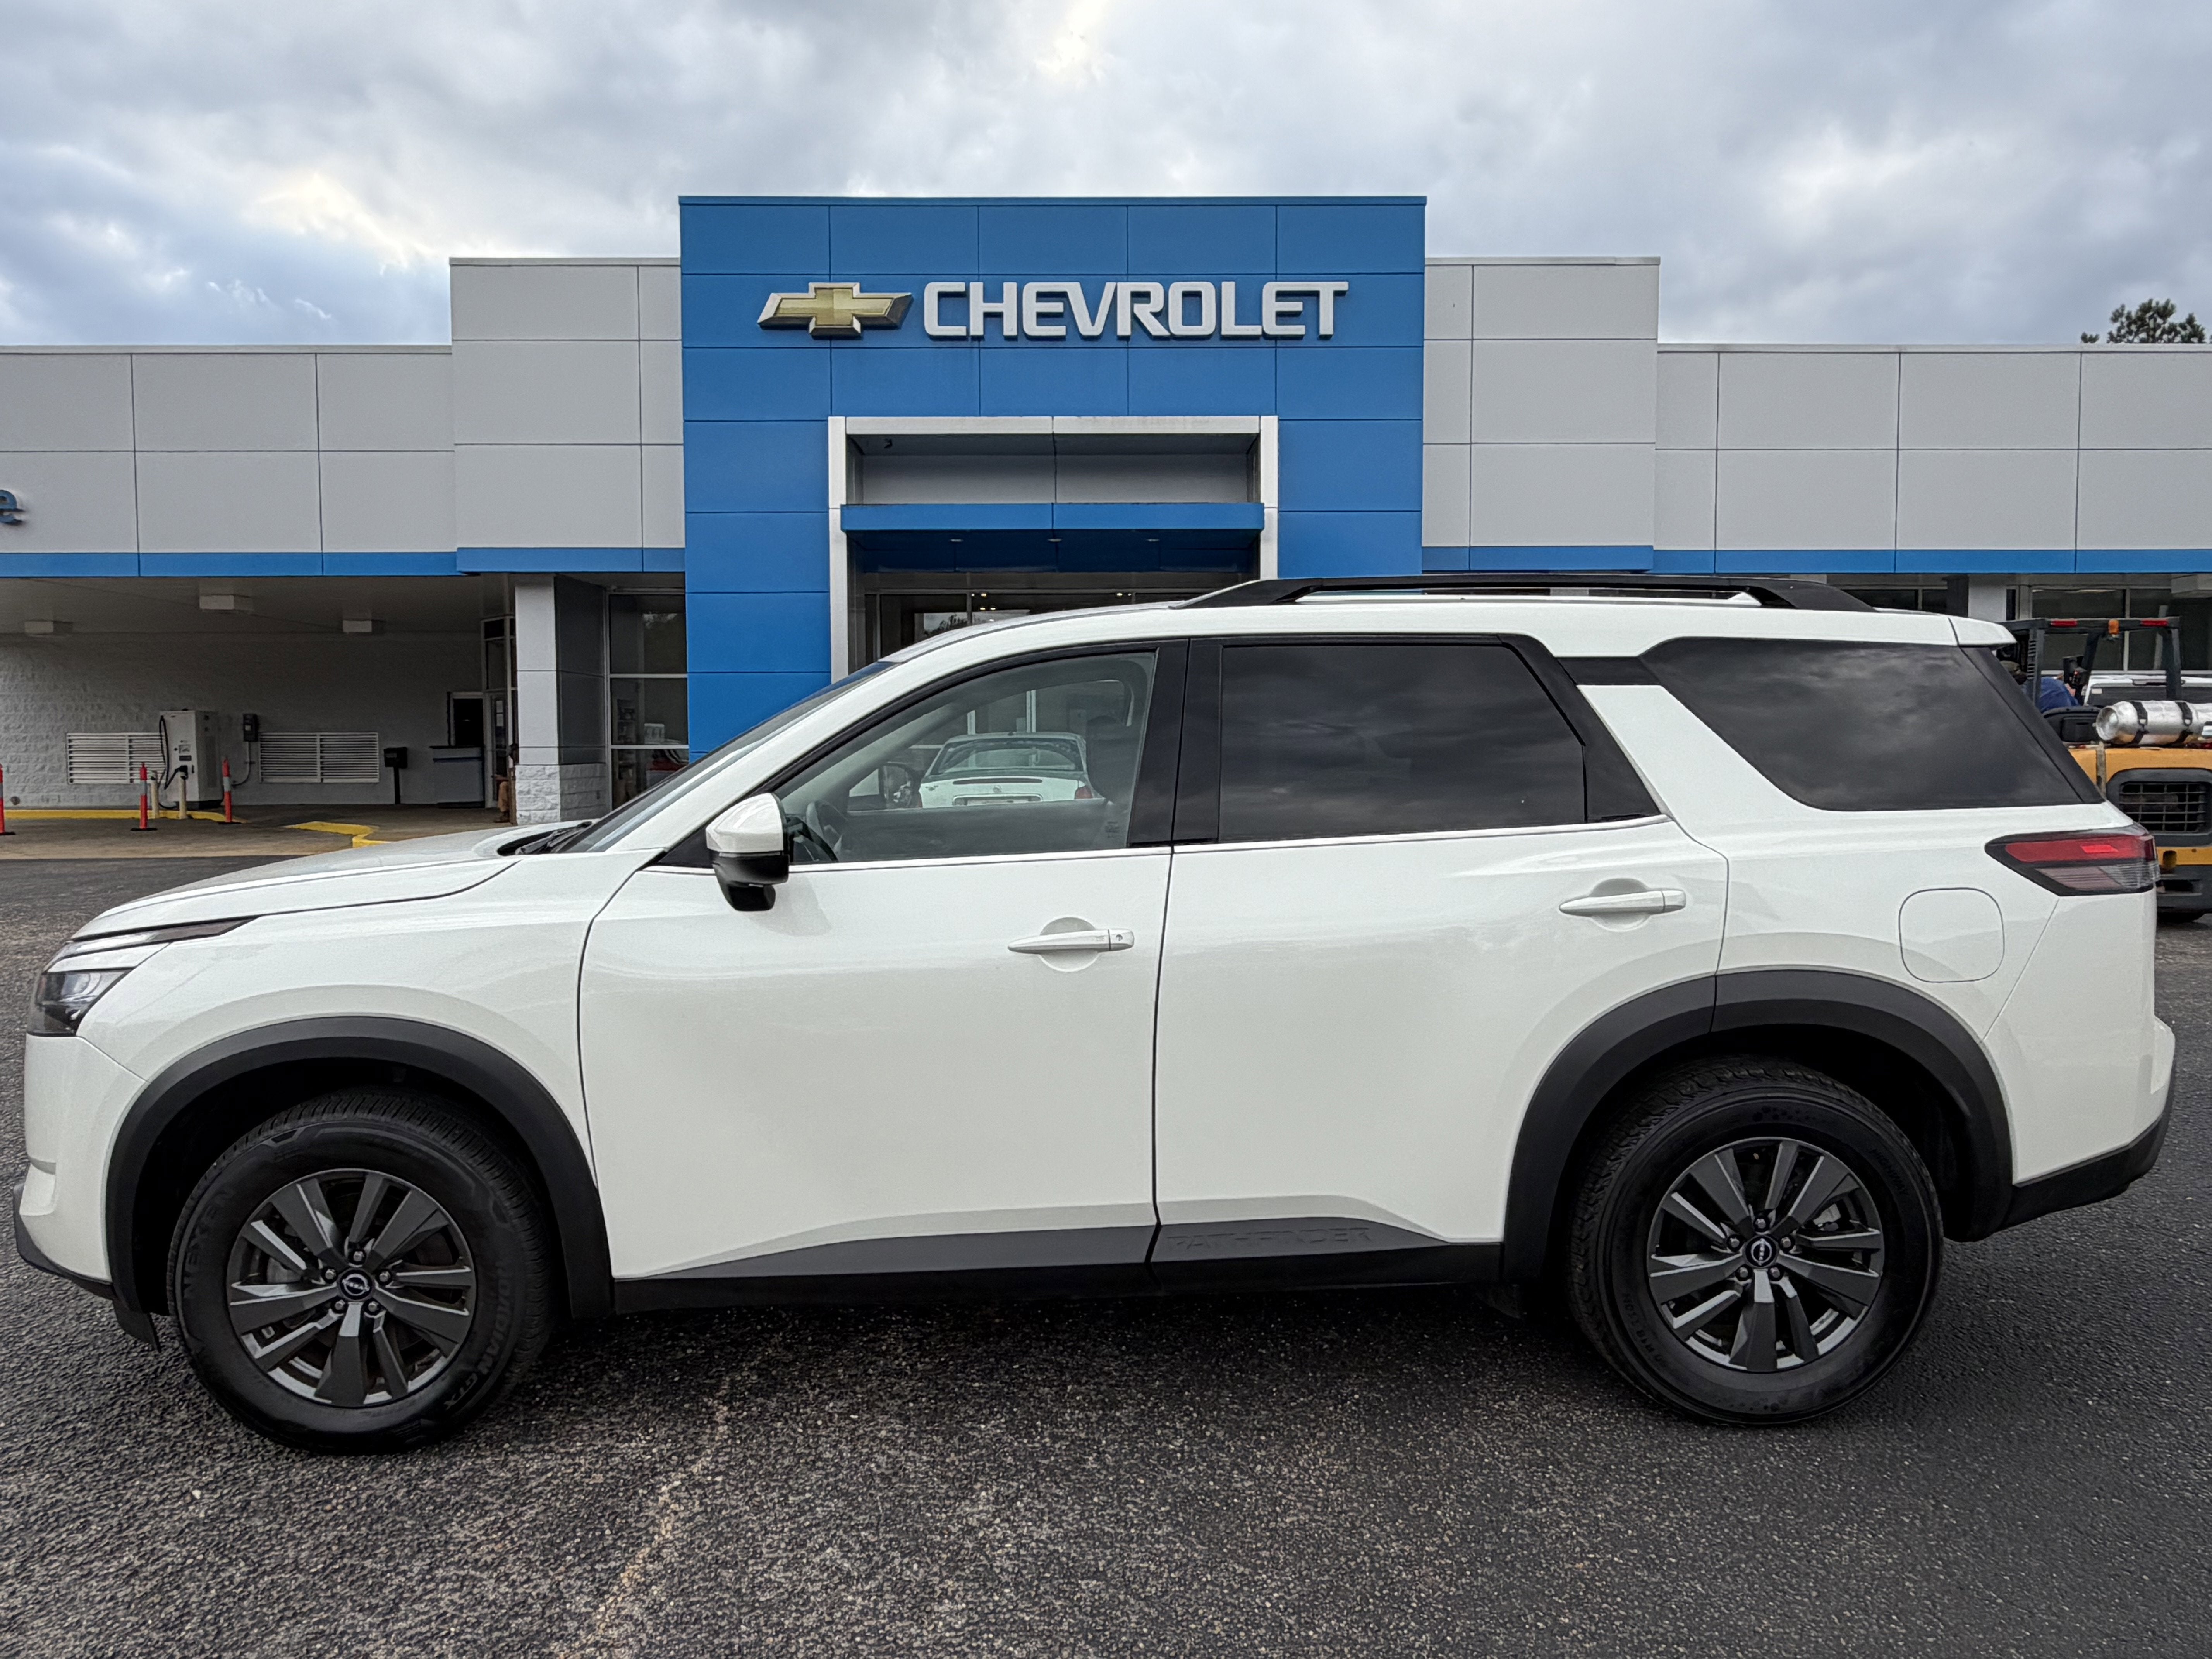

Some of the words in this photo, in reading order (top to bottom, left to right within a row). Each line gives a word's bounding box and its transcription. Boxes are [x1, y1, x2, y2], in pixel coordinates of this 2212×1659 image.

[924, 281, 1349, 339] CHEVROLET
[182, 1187, 235, 1298] NEXEN
[1166, 1227, 1373, 1251] PATHFINDER
[443, 1372, 478, 1411] GTX
